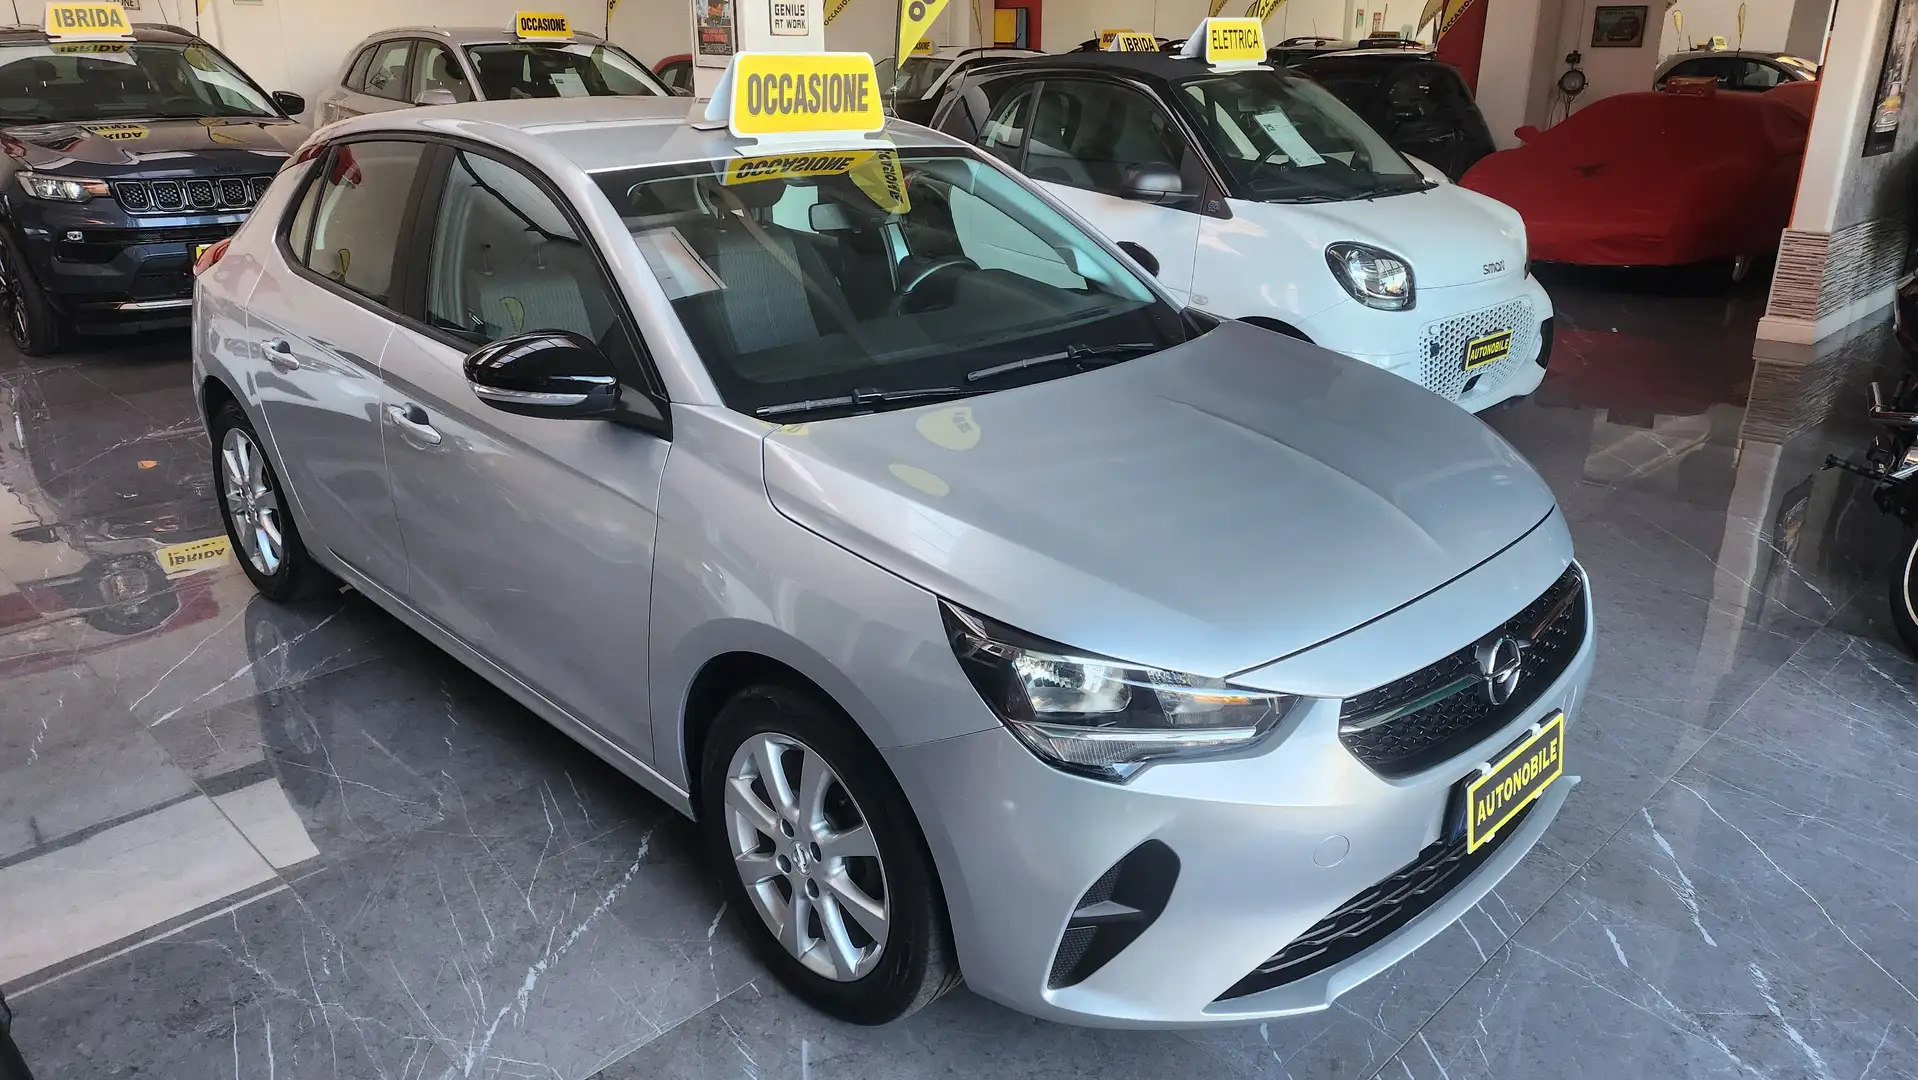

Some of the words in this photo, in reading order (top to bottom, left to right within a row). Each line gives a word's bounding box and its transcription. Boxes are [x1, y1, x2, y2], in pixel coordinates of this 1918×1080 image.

[53, 9, 123, 28] IBRIDA
[774, 4, 806, 16] GENIUS
[823, 0, 851, 26] OCCASIO
[1442, 0, 1475, 33] OCCASIO
[520, 17, 567, 32] OCCASIONE
[775, 19, 784, 29] AT
[786, 19, 806, 29] WORK
[1123, 37, 1155, 51] IBRIDA
[1211, 29, 1260, 50] ELETTRICA
[747, 72, 869, 116] OCCASIONE
[1482, 260, 1506, 276] smart
[1469, 338, 1510, 362] AUTONOBILE
[1476, 736, 1558, 827] AUTONOBILE
